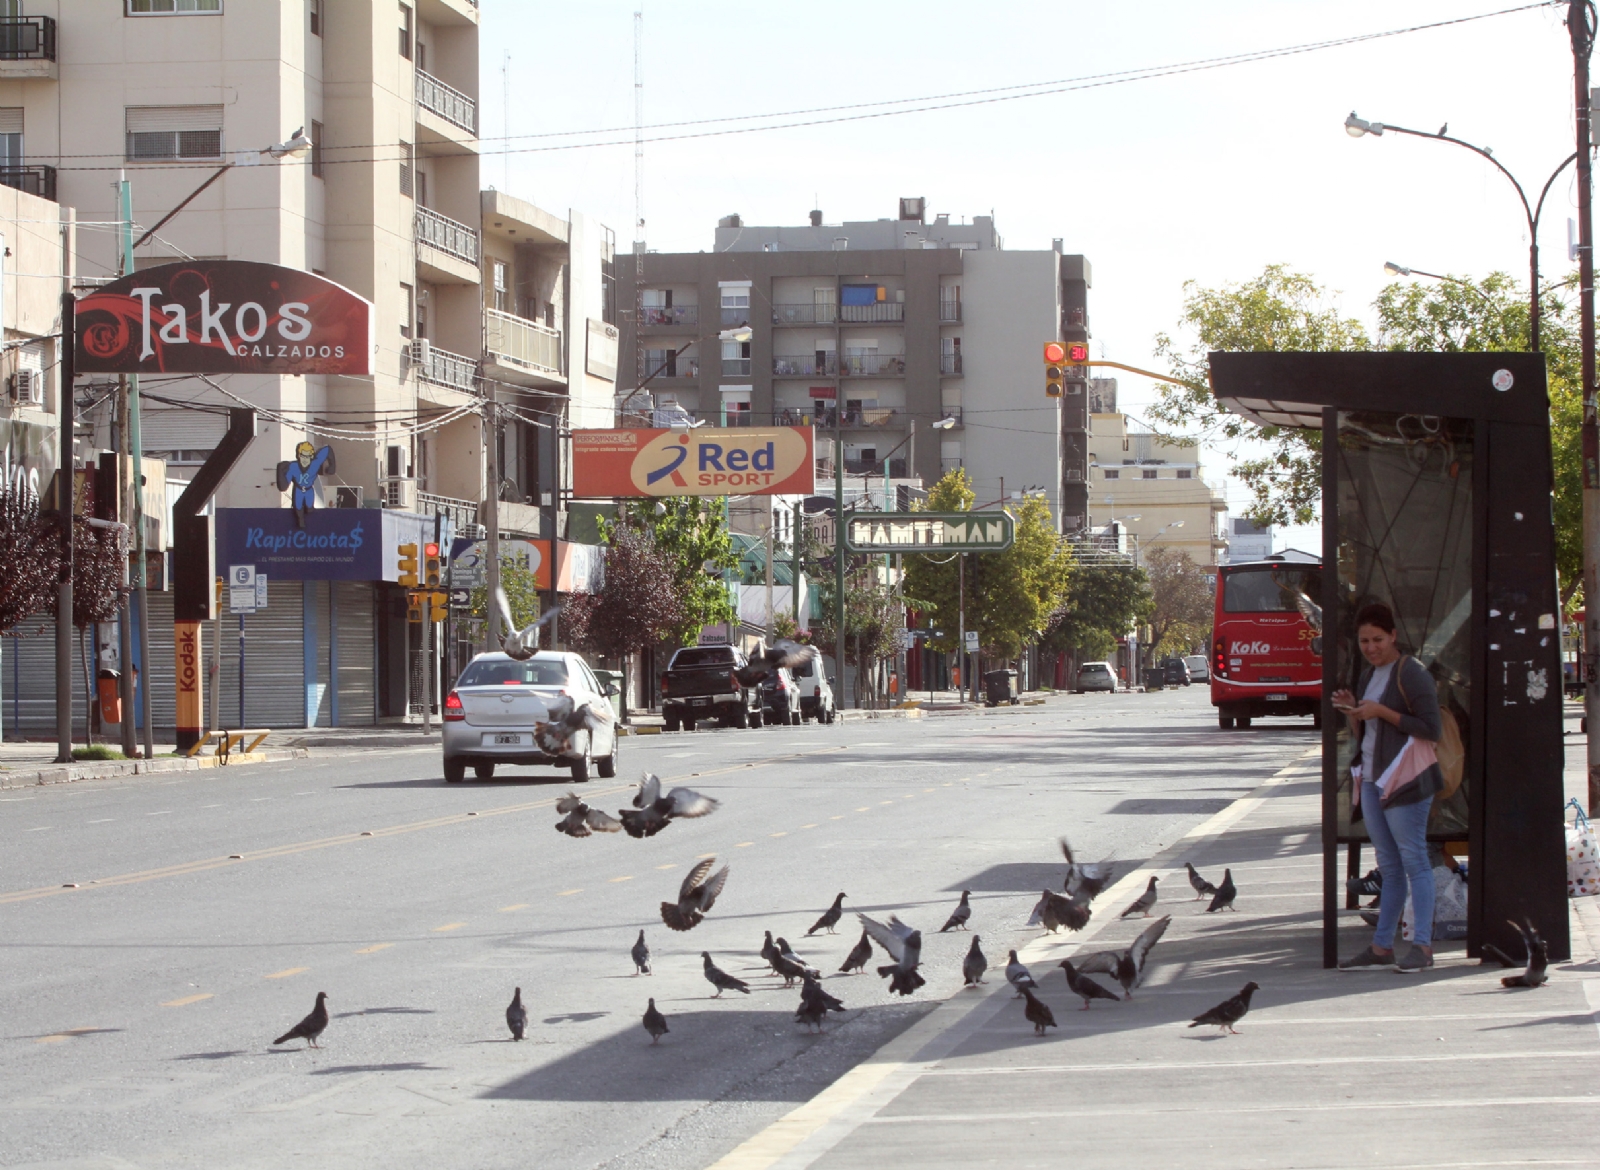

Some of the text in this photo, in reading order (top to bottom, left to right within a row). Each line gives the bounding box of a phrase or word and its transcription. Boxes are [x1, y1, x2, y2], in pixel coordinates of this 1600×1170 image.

[130, 287, 312, 362] Takos
[237, 345, 345, 358] CALZADOS
[698, 442, 775, 471] Red
[698, 473, 775, 486] SPORT
[245, 521, 364, 555] RapiCuota$
[179, 631, 196, 692] Kodak
[1230, 641, 1271, 654] KoKo
